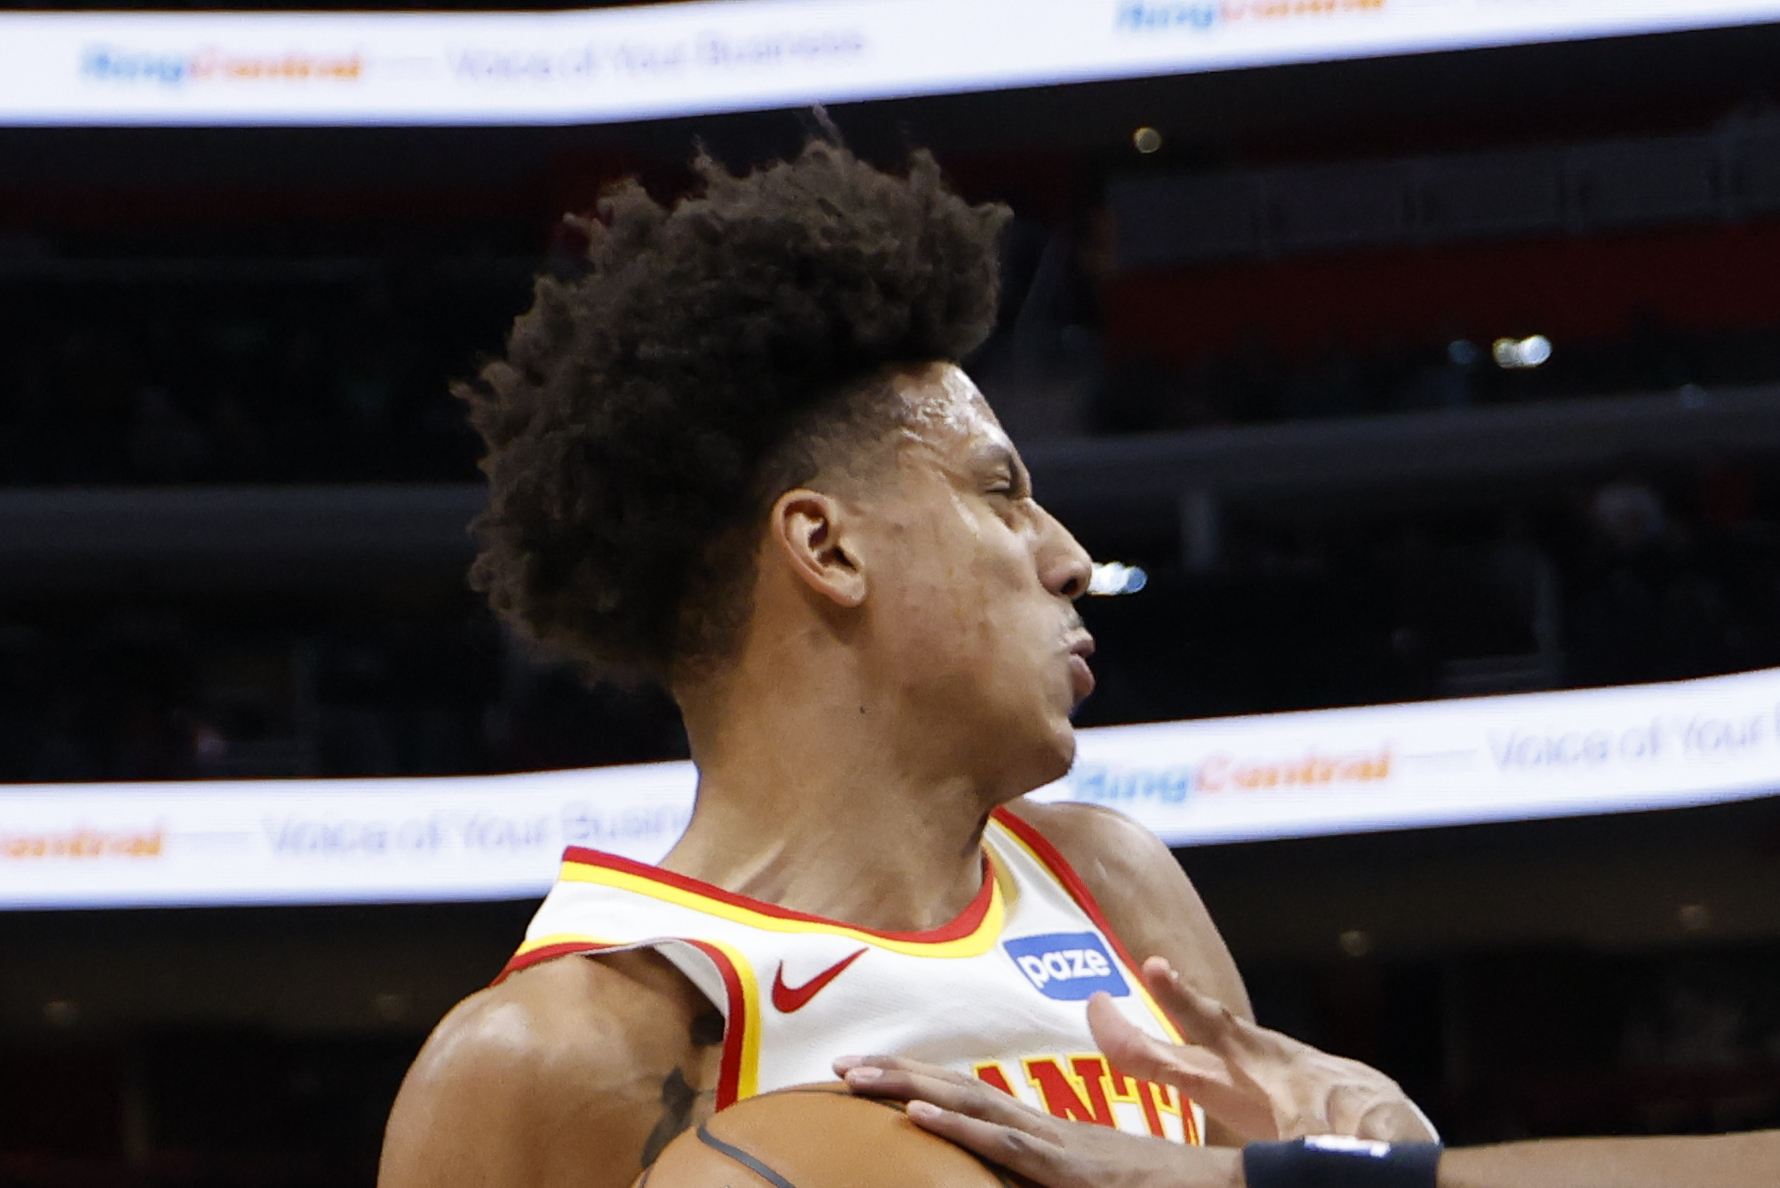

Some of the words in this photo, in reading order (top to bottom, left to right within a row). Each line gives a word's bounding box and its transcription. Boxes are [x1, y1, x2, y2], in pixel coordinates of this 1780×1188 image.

[80, 42, 365, 90] RingCentral
[1074, 740, 1393, 804] RingCentral
[1488, 724, 1612, 770] Voice
[1619, 715, 1663, 762] of
[1670, 712, 1764, 755] Your
[1017, 948, 1112, 988] paze
